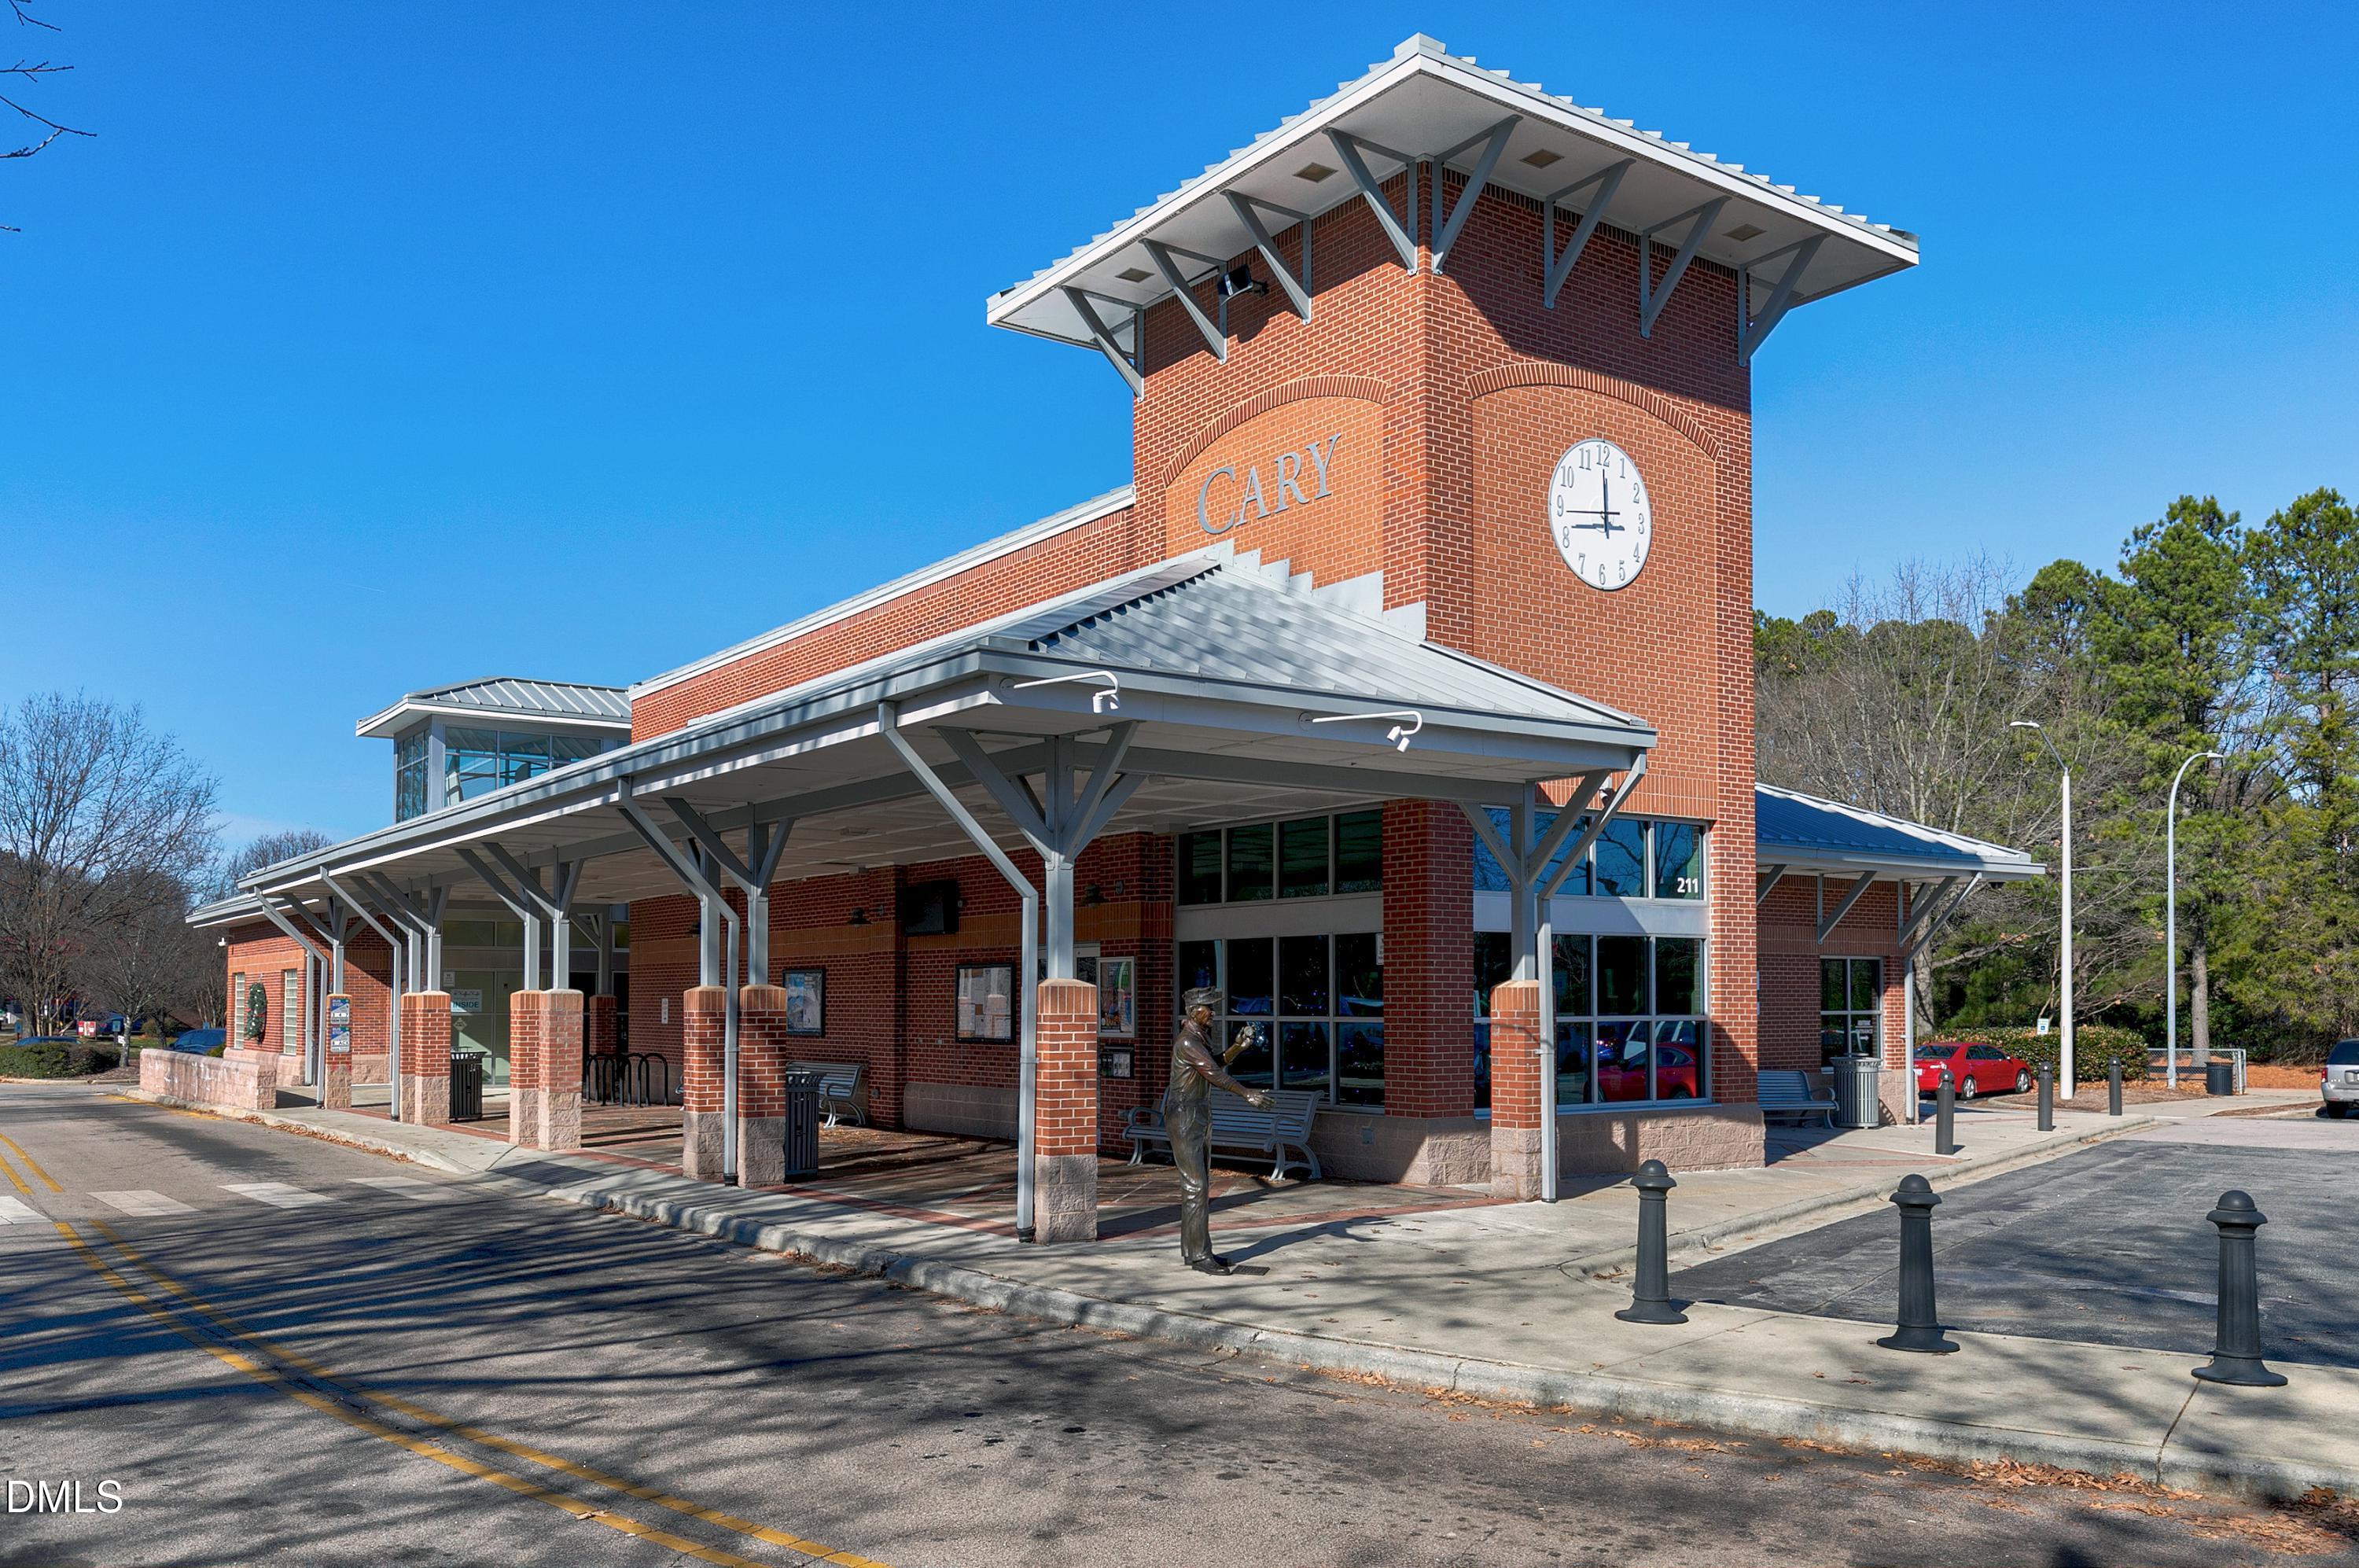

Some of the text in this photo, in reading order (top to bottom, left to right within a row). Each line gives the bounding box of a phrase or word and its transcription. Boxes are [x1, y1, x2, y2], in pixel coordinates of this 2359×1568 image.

[1578, 447, 1592, 470] 11
[1596, 444, 1610, 468] 12
[1560, 465, 1574, 488] 10
[1620, 458, 1626, 479] 1
[1198, 432, 1341, 535] CARY
[1632, 482, 1640, 503] 2
[1557, 494, 1564, 517] 9
[1638, 513, 1645, 535] 3
[1562, 525, 1570, 548] 8
[1578, 552, 1586, 575] 7
[1632, 542, 1640, 563] 4
[1599, 563, 1606, 585] 6
[1619, 560, 1626, 581] 5
[1677, 877, 1698, 893] 211
